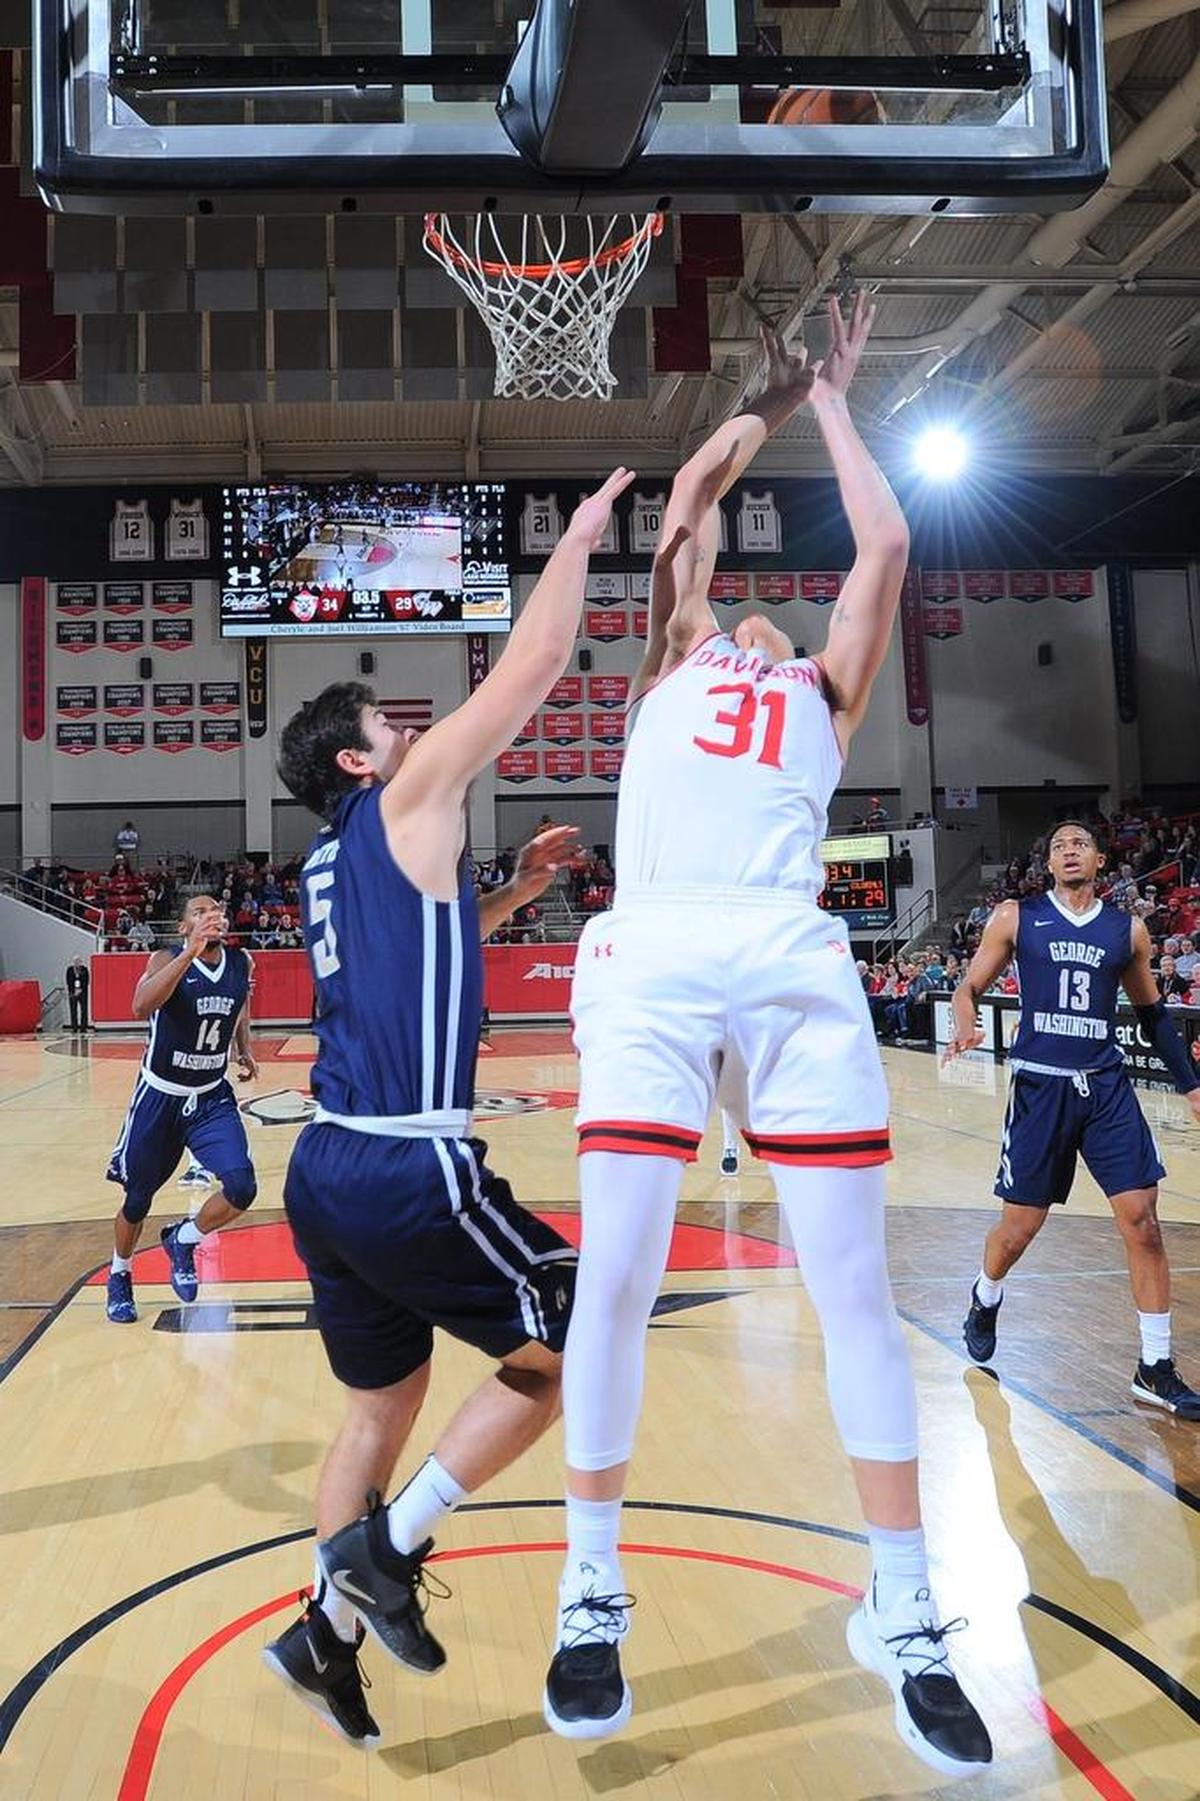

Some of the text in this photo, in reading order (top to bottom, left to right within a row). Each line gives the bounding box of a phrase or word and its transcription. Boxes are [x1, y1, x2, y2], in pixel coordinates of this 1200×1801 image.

[125, 521, 140, 539] 12
[179, 520, 195, 538] 31
[534, 515, 549, 533] 21
[643, 514, 659, 531] 10
[753, 514, 764, 530] 11
[322, 598, 338, 611] 34
[395, 597, 412, 610] 29
[249, 646, 263, 704] VCU
[694, 682, 784, 770] 31
[865, 890, 884, 906] 29
[306, 870, 341, 979] 5
[1048, 941, 1106, 968] GEORGE
[1058, 969, 1090, 1010] 13
[197, 998, 234, 1015] GEORGE
[196, 1019, 221, 1050] 14
[1034, 1012, 1108, 1040] WASHINGTON
[172, 1050, 226, 1068] WASHINGTON
